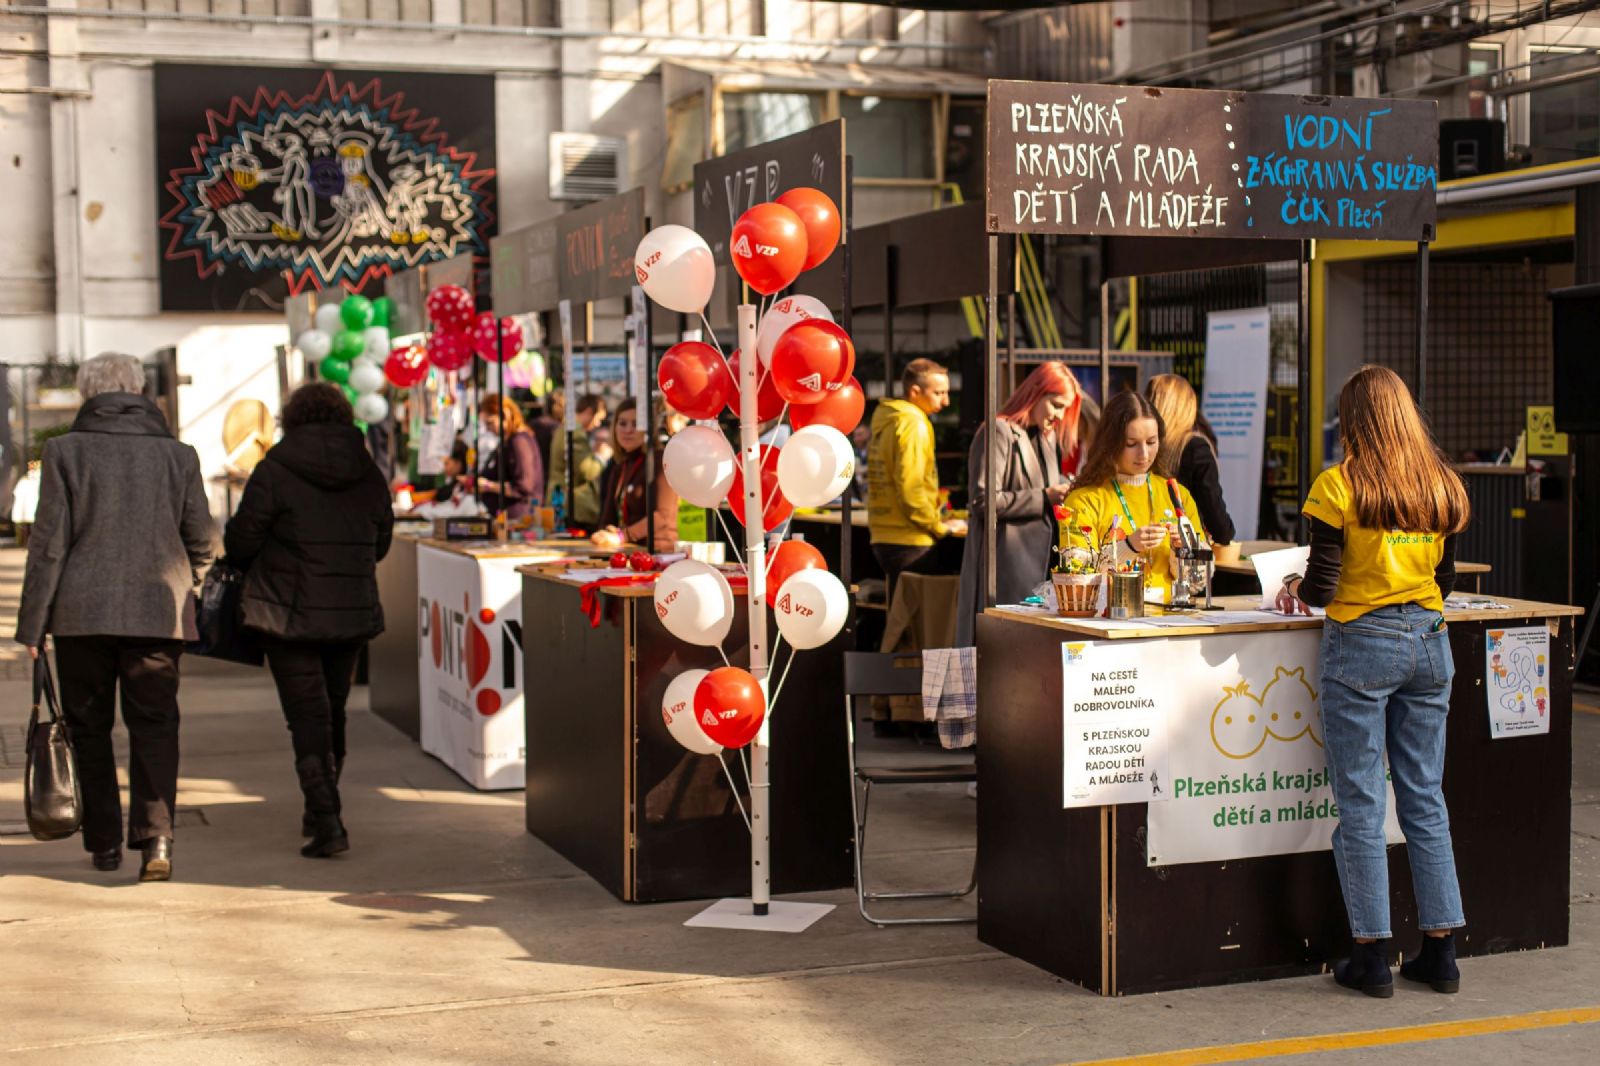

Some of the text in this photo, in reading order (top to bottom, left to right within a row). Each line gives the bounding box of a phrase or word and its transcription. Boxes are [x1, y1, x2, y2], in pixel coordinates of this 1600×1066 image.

[1011, 95, 1127, 136] PLZEŇSKÁ
[1284, 108, 1393, 150] VODNÍ
[1015, 142, 1199, 185] KRAJSKÁ RADA
[1246, 152, 1437, 191] ZÁCHRANNÁ SLUŽBA
[1013, 184, 1229, 229] DĚTÍ A MLÁDEŽE
[1280, 191, 1386, 228] ČČK Plzeň
[755, 244, 779, 257] VZP
[644, 251, 662, 268] VZP
[664, 590, 679, 605] VZP
[795, 603, 814, 618] VZP
[1091, 672, 1107, 681] NA
[1093, 684, 1135, 696] MALÉHO
[670, 701, 687, 714] VZP
[1074, 697, 1155, 712] DOBROVOLNÍKA
[718, 708, 738, 720] VZP
[1083, 727, 1150, 741] S PLZEŇSKOU
[1088, 744, 1142, 755] KRAJSKOU
[1085, 755, 1145, 771] RADOU DĚTÍ
[1089, 771, 1144, 785] A MLÁDEŽE
[1174, 766, 1332, 798] Plzeňská krajsk
[1213, 798, 1340, 828] dětí a mláde
